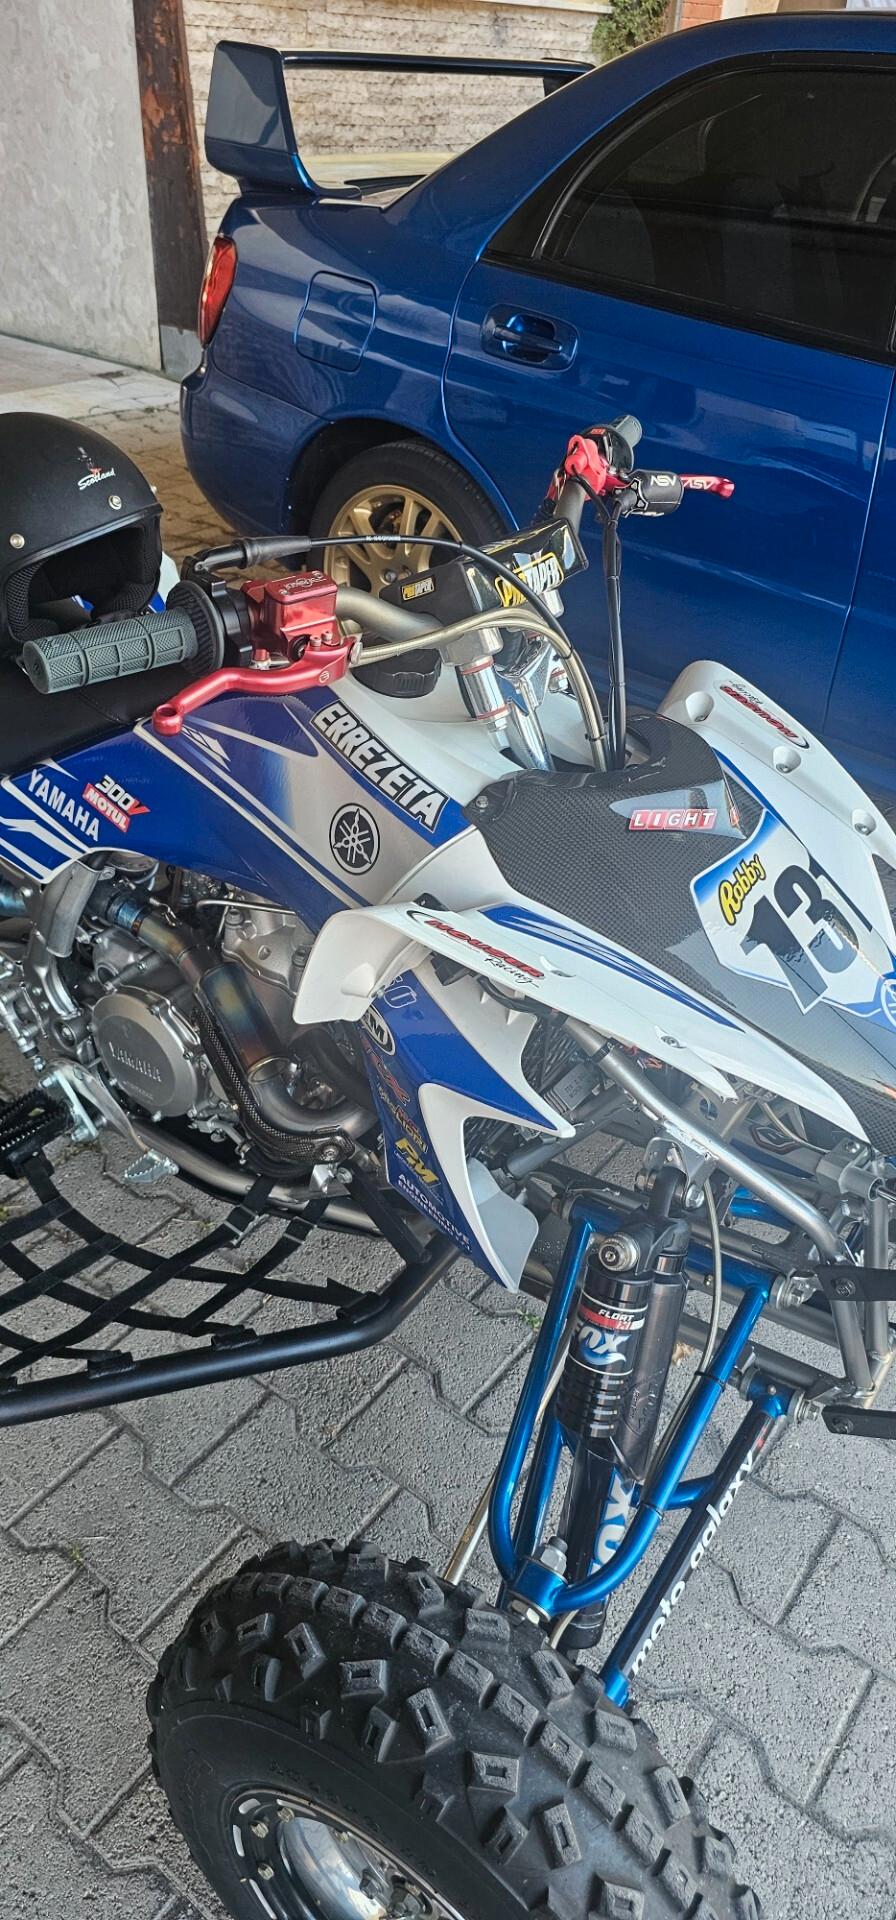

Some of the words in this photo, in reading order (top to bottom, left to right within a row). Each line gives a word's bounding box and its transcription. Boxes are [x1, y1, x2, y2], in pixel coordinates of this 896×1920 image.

[313, 702, 447, 828] ERREZETA
[28, 768, 100, 842] YAMAHA
[86, 787, 129, 831] MOTUL
[95, 774, 151, 815] 300V
[633, 812, 714, 827] LIGHT
[719, 853, 767, 926] Robby
[484, 955, 540, 989] Racing
[108, 1041, 162, 1082] YAMAHA
[398, 1179, 454, 1236] ENGINEERING
[398, 1174, 470, 1245] AUTOMOTIVE
[598, 1308, 635, 1321] FLOAT
[690, 1449, 753, 1570] galaxy
[632, 1580, 686, 1675] moto
